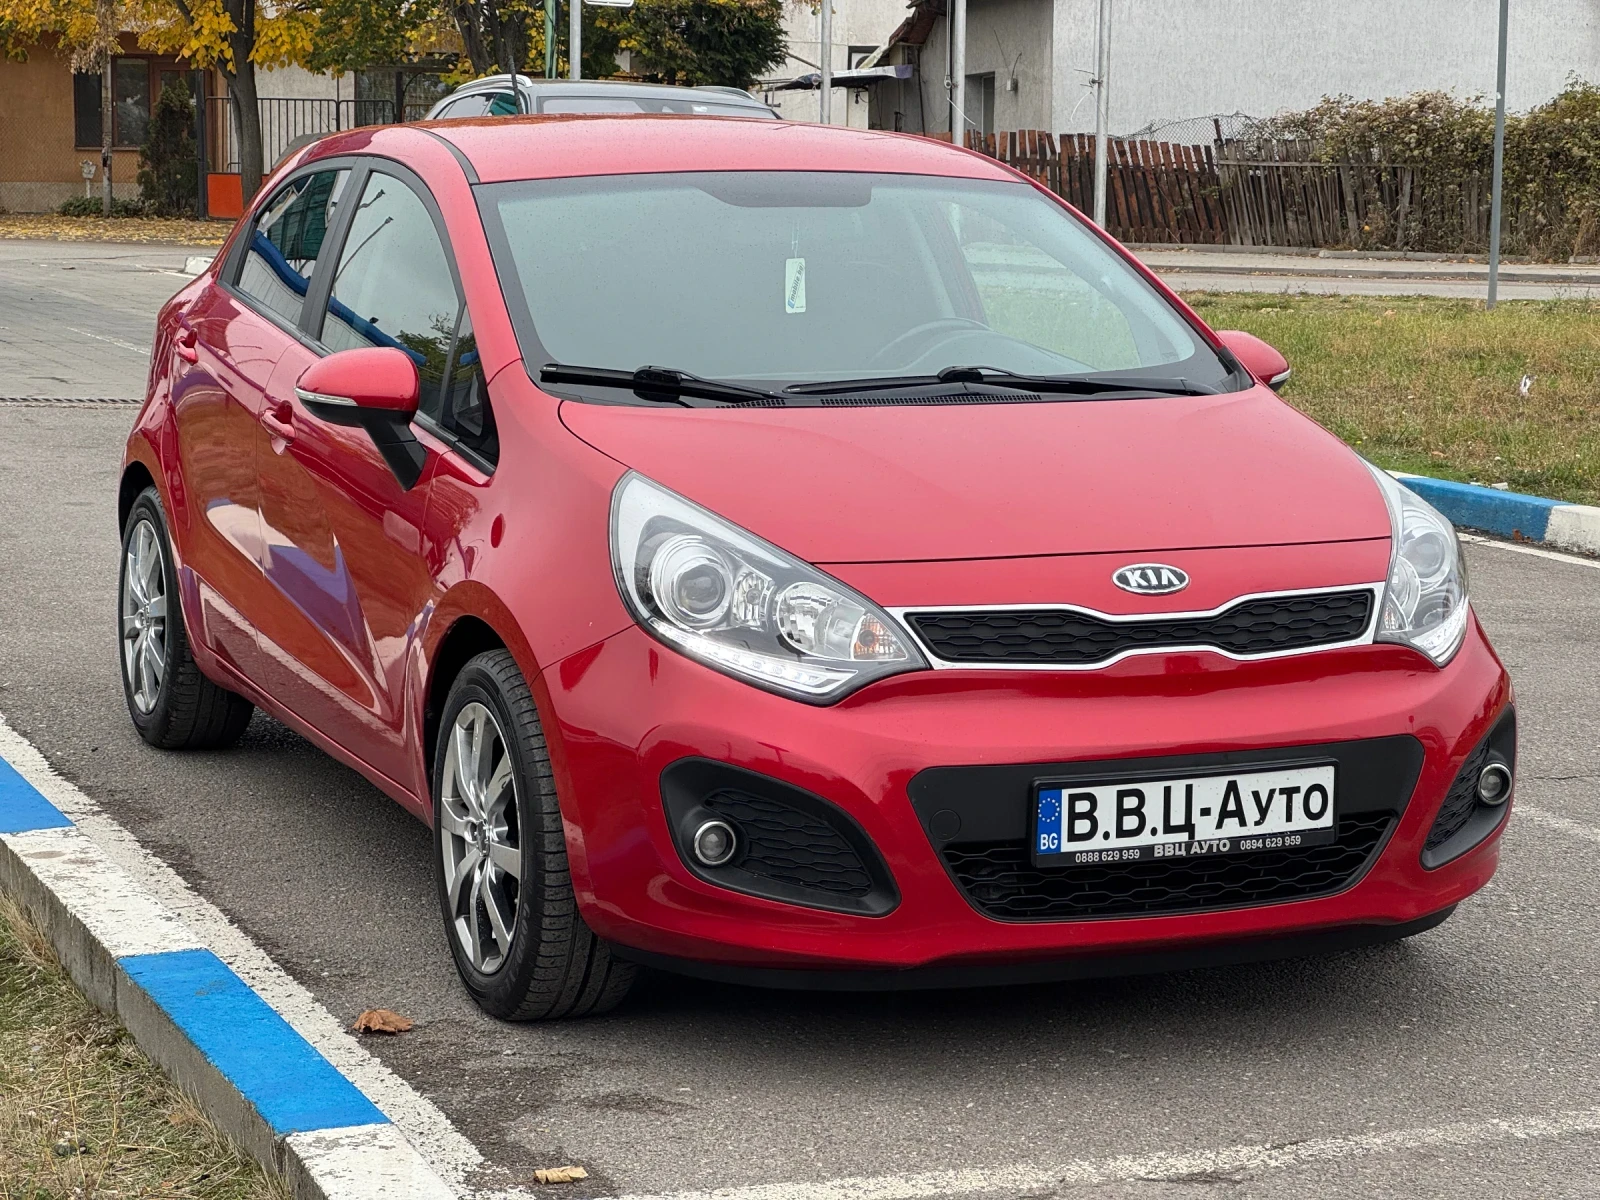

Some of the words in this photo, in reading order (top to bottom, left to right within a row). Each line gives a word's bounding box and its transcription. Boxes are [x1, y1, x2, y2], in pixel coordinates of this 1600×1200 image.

[1124, 568, 1181, 587] KIA
[1040, 832, 1058, 850] BG
[1075, 851, 1100, 863] 0888
[1101, 850, 1120, 861] 629
[1122, 848, 1140, 860] 959
[1153, 842, 1187, 858] ВВЦ
[1190, 839, 1231, 854] АУТО
[1240, 839, 1263, 851] 0894
[1265, 837, 1283, 848] 629
[1284, 835, 1302, 847] 959
